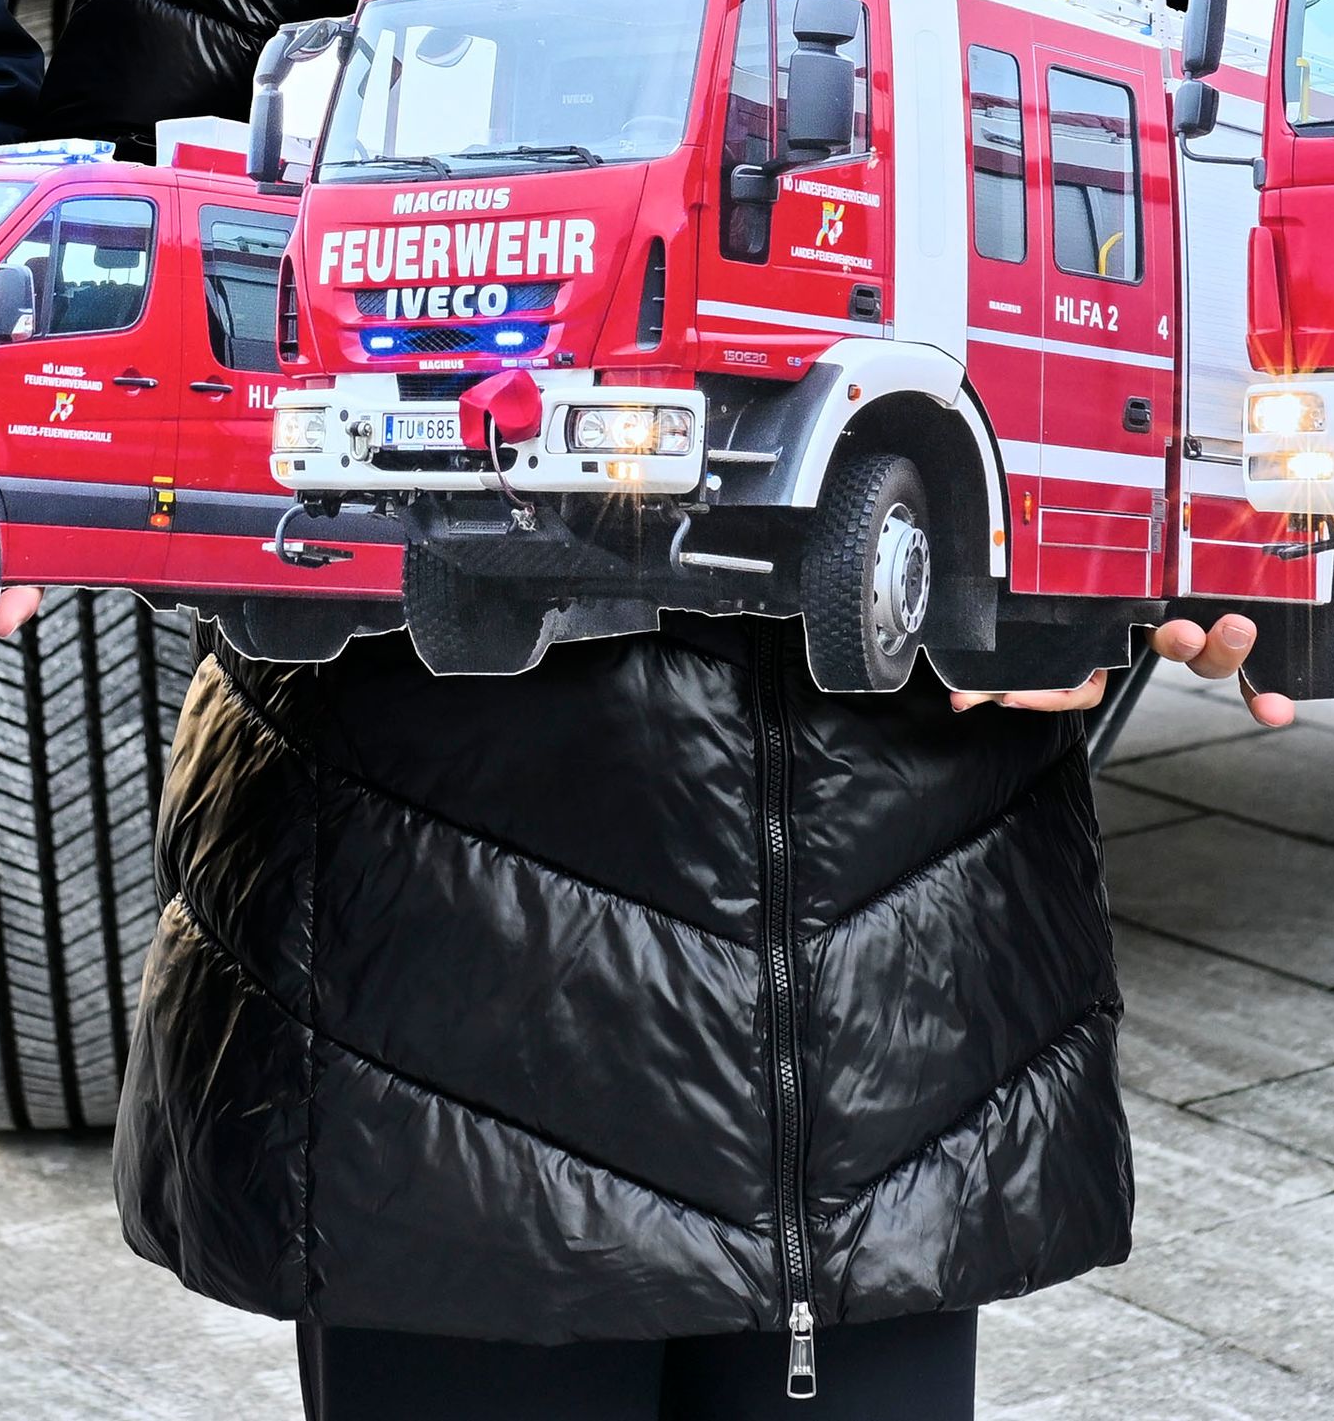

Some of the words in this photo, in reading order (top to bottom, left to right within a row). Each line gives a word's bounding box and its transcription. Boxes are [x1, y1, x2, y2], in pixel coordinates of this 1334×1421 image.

[393, 187, 511, 215] MAGIRUS
[319, 218, 596, 285] FEUERWEHR
[385, 283, 509, 320] IVECO
[1055, 295, 1103, 329] HLFA
[1107, 305, 1119, 331] 2
[1158, 315, 1169, 340] 4
[419, 360, 464, 370] MAGIRUS
[397, 420, 415, 439] TU
[427, 420, 455, 439] 685
